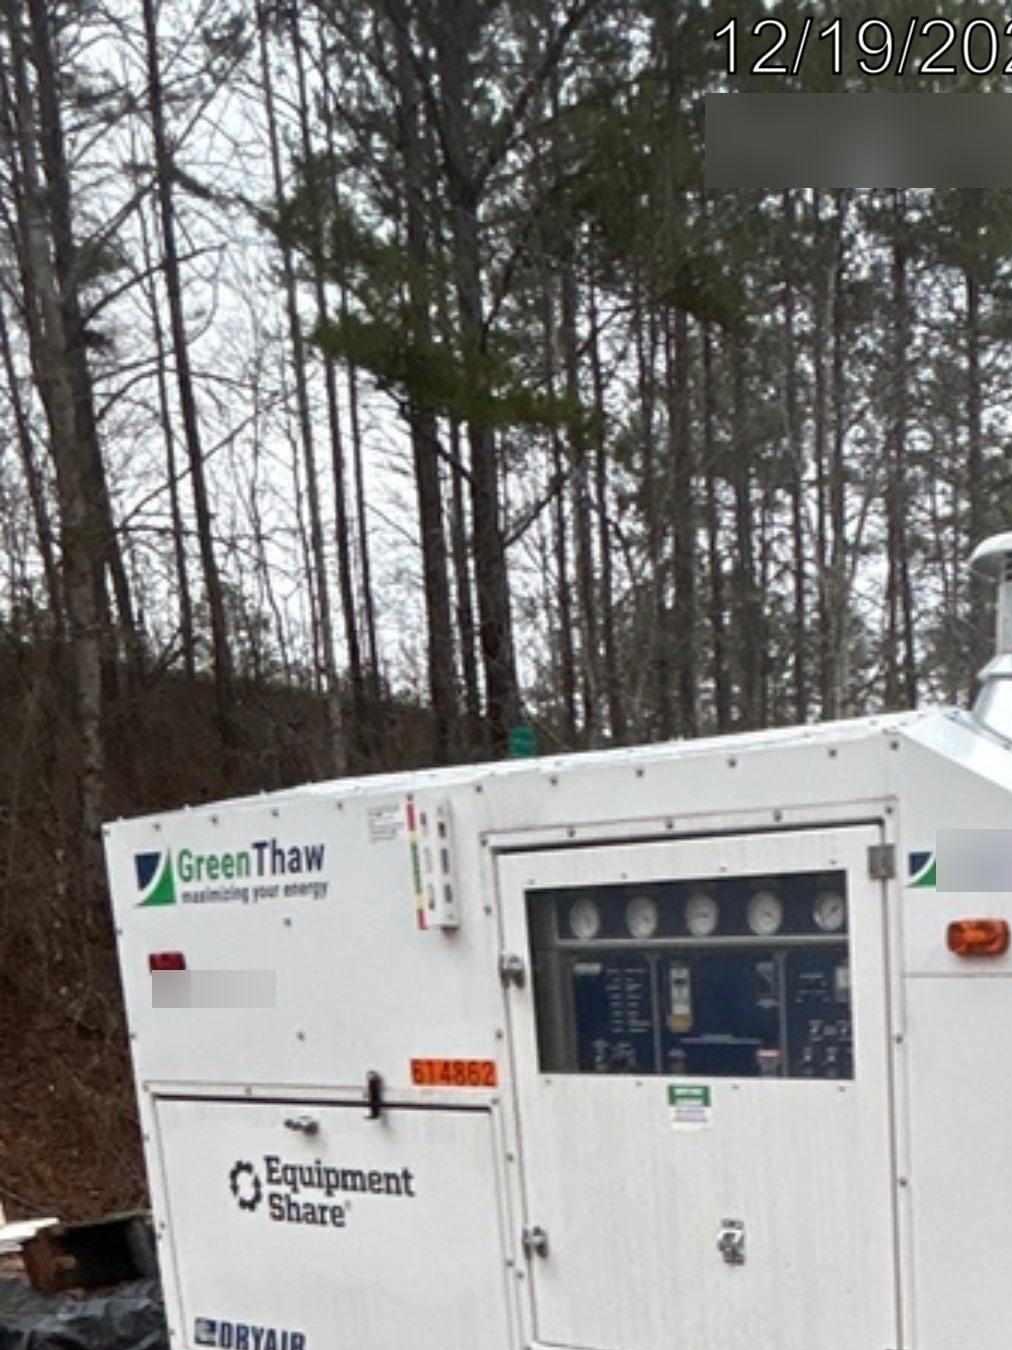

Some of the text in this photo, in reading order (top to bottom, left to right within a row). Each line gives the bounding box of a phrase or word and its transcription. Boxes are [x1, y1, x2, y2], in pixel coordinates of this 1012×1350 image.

[177, 837, 326, 882] GreenThaw
[181, 881, 328, 904] maximizing your energy
[411, 1060, 497, 1087] 614862
[264, 1155, 415, 1197] Equipment
